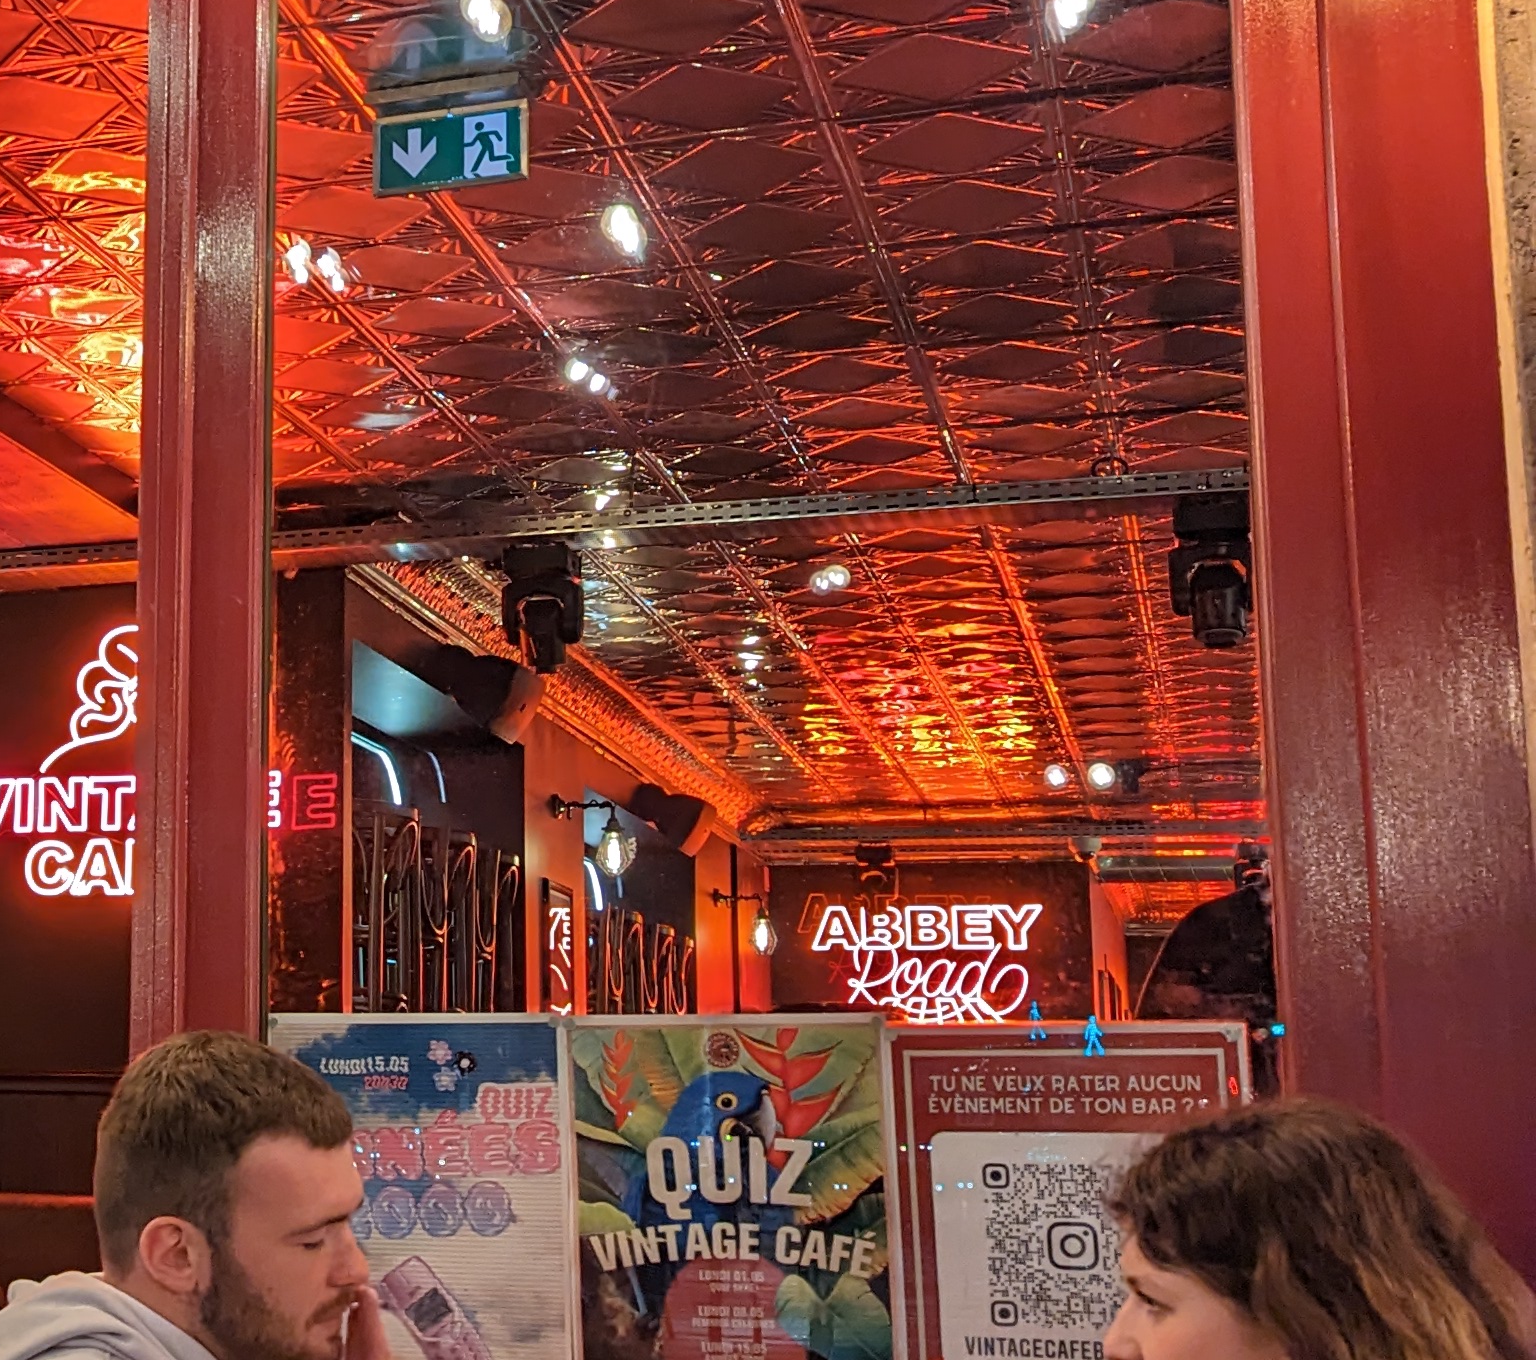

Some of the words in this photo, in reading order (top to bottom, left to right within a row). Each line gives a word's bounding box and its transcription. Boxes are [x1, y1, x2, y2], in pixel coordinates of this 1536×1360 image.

[24, 838, 135, 896] CA
[811, 903, 1043, 951] ABBEY
[848, 937, 1029, 1016] Road
[479, 1086, 554, 1124] QUIZ
[928, 1074, 955, 1092] TU
[961, 1074, 986, 1092] NE
[992, 1074, 1044, 1092] VEUX
[1051, 1074, 1120, 1092] RATER
[1126, 1074, 1202, 1092] AUCUN
[928, 1092, 1042, 1115] ÉVÈNEMENT
[1049, 1097, 1075, 1114] DE
[1080, 1097, 1127, 1114] TON
[1132, 1097, 1176, 1114] BAR
[646, 1136, 814, 1221] QUIZ
[590, 1222, 760, 1273] VINTAGE
[775, 1225, 878, 1279] CAFÉ
[965, 1336, 1105, 1360] VINTAGECAFEB
